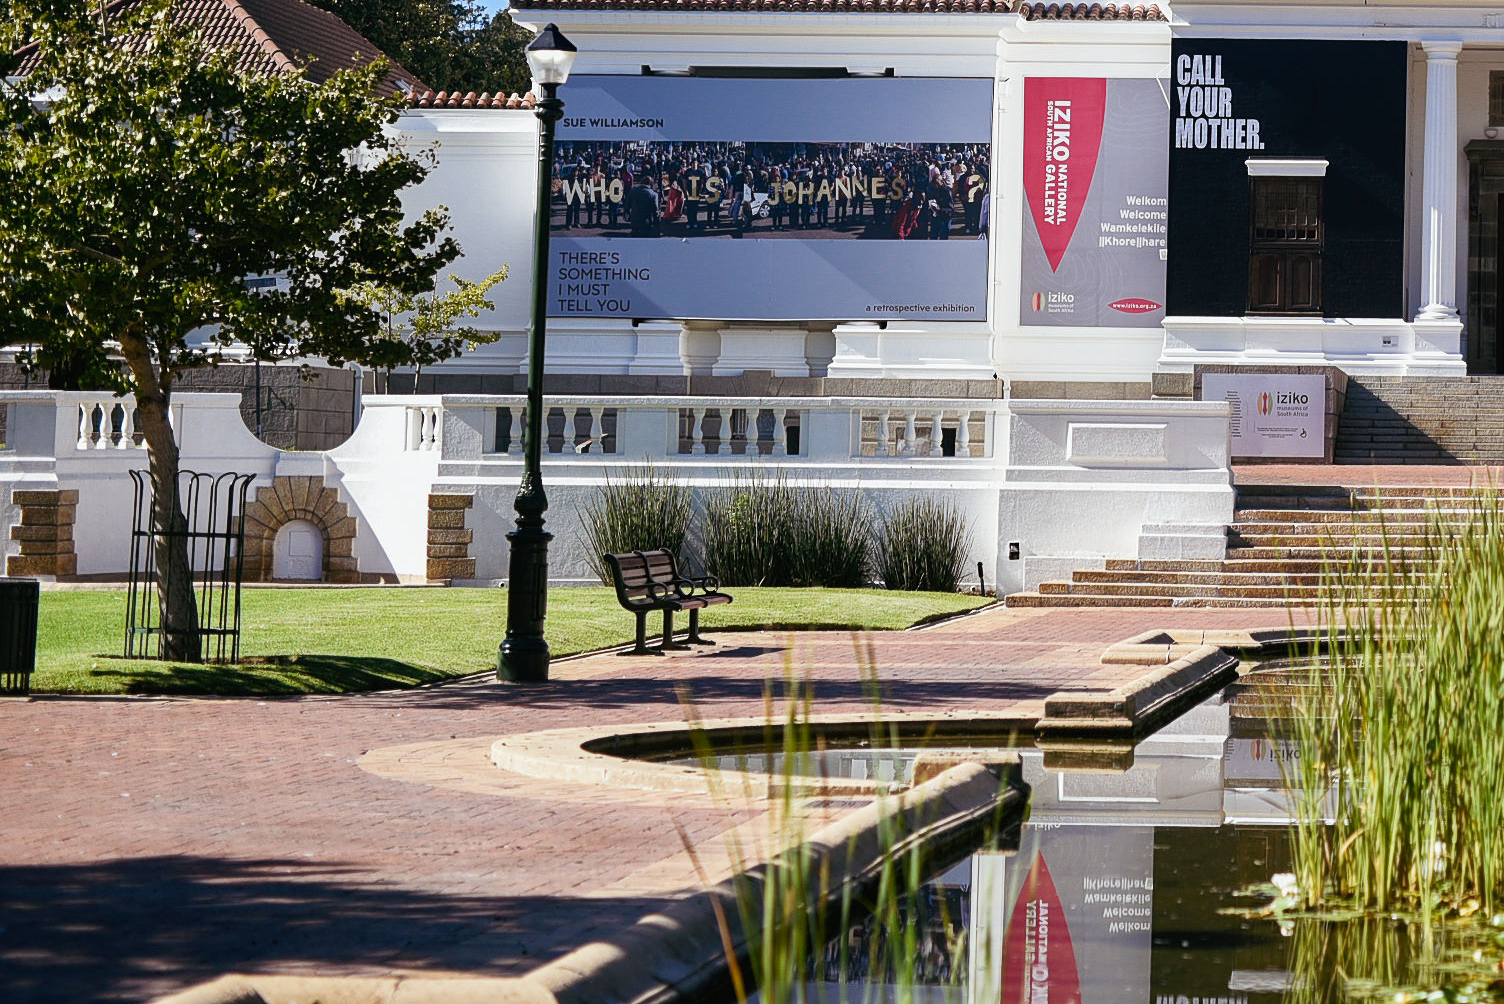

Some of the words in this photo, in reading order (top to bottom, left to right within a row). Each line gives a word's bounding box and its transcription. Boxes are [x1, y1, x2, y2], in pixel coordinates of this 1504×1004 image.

[1177, 54, 1225, 86] CALL
[1176, 86, 1233, 117] YOUR
[1046, 100, 1054, 126] SOUTH
[563, 118, 587, 128] SUE
[589, 118, 664, 128] WILLIAMSON
[1052, 100, 1071, 162] IZIKO
[1175, 117, 1265, 150] MOTHER.
[1045, 127, 1053, 161] AFRICAN
[562, 178, 624, 206] WHO
[687, 176, 722, 203] IS
[767, 176, 906, 206] JOHANNES
[1044, 164, 1056, 225] GALLERY
[1056, 164, 1068, 226] NATIONAL
[1126, 195, 1167, 206] Welkom
[1119, 209, 1167, 219] Welcome
[1100, 222, 1166, 233] Wamkelekile
[559, 252, 620, 264] THERE'S
[558, 267, 650, 281] SOMETHING
[558, 283, 562, 296] I
[567, 283, 610, 296] MUST
[1048, 291, 1075, 303] iziko
[557, 299, 593, 312] TELL
[597, 299, 631, 312] YOU
[873, 303, 931, 314] retrospective
[932, 303, 975, 313] exhibition
[1276, 391, 1309, 405] iziko
